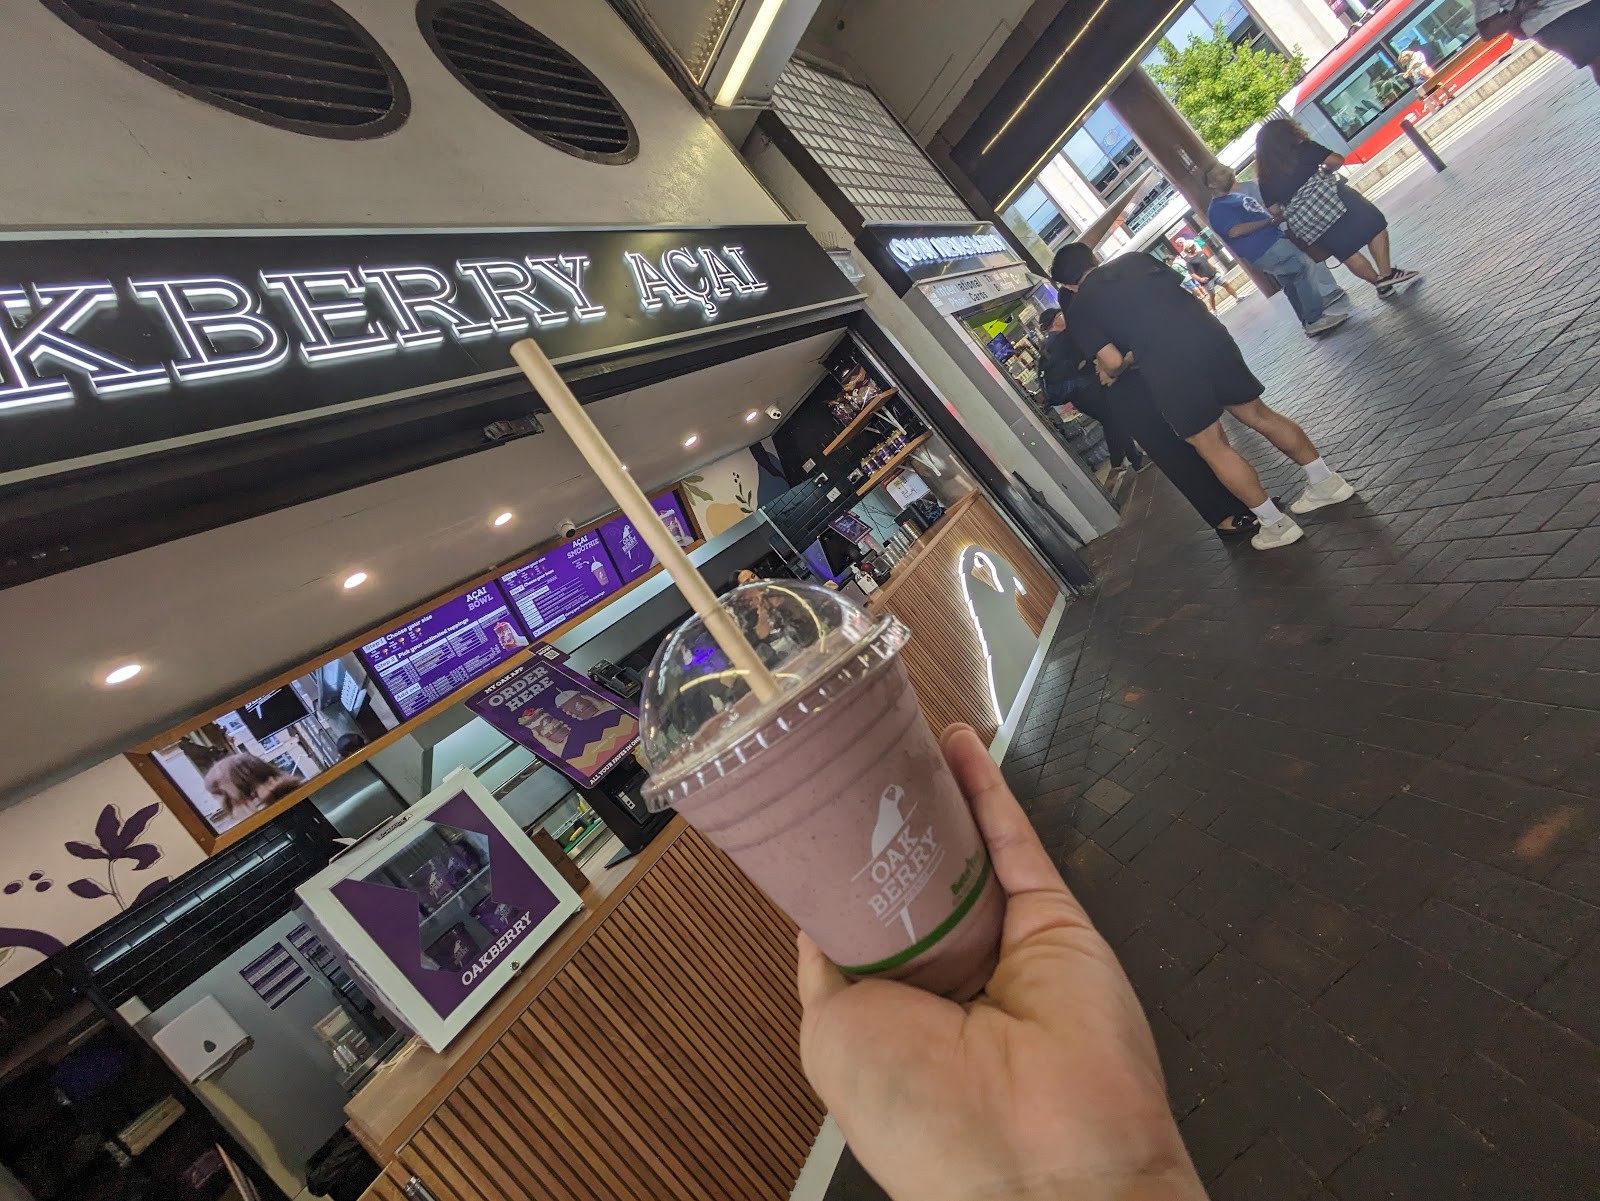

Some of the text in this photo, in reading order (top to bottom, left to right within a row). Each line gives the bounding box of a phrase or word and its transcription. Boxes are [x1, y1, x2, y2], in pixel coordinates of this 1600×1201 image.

[625, 244, 768, 318] AÇAI
[933, 277, 982, 297] International
[968, 290, 989, 303] Cards
[566, 538, 600, 559] SMOOTHIE
[572, 535, 589, 548] AÇAI
[466, 586, 488, 603] AÇAI
[467, 594, 494, 611] BOWL
[386, 627, 408, 641] Choose
[407, 620, 421, 632] your
[421, 614, 433, 624] size
[376, 659, 391, 671] Step
[397, 648, 411, 659] Pick
[410, 641, 424, 654] your
[423, 627, 448, 645] unlimited
[446, 617, 470, 632] toppings
[396, 684, 420, 700] Add ons
[484, 666, 524, 694] MY OAK APP
[488, 666, 549, 707] ORDER
[504, 676, 555, 711] HERE
[589, 774, 601, 786] ALL
[598, 761, 614, 776] YOUR
[611, 749, 628, 764] FAVES
[625, 743, 633, 752] IN
[872, 825, 918, 884] OAK
[867, 825, 937, 918] BERRY
[461, 911, 532, 985] OAKBERRY
